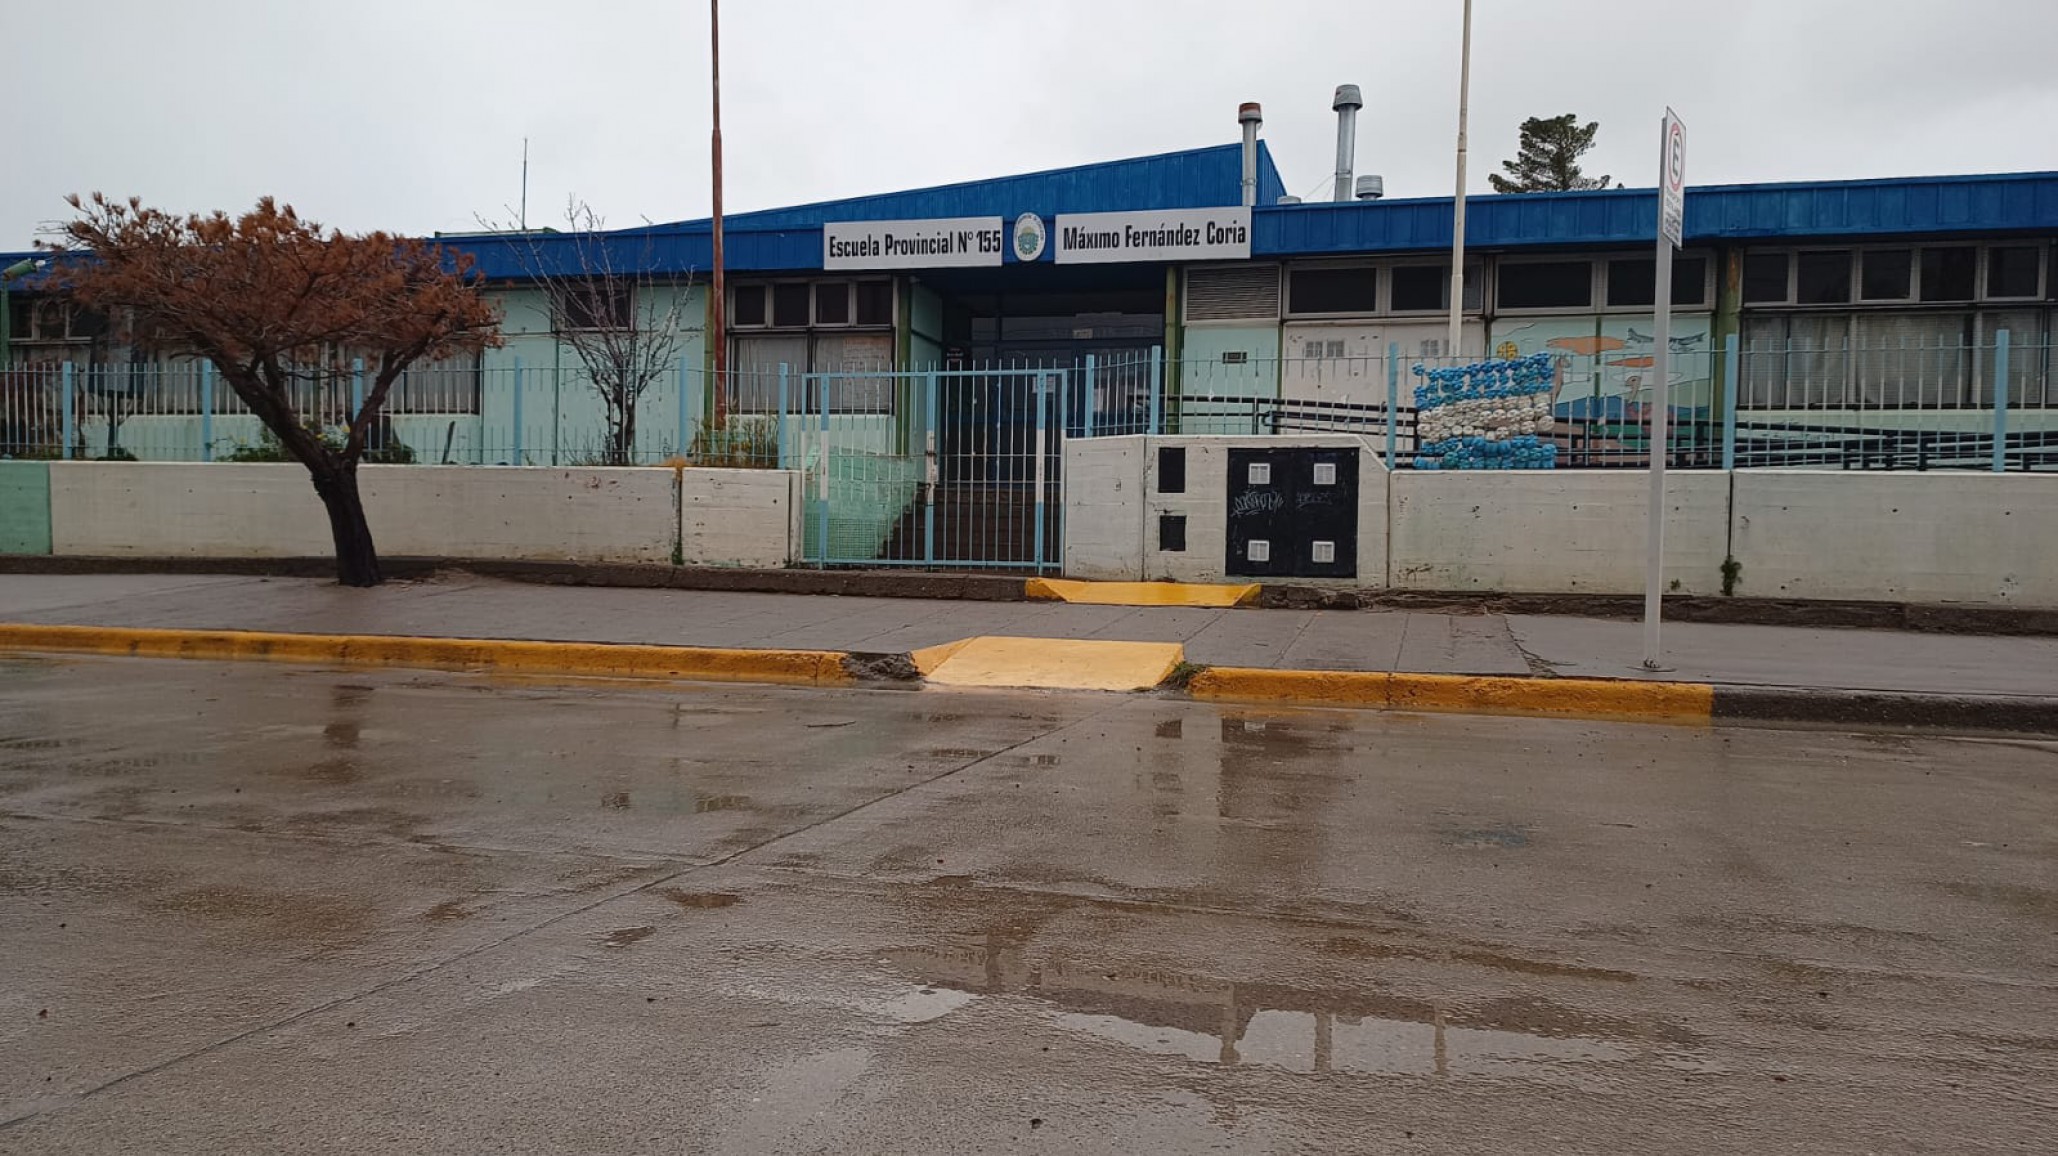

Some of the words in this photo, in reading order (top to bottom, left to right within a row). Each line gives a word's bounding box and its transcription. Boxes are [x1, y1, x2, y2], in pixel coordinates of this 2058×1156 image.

[829, 233, 880, 258] Escuela
[884, 231, 953, 256] Provincial
[976, 229, 1001, 254] 155
[1125, 222, 1201, 248] Fernández
[1206, 219, 1247, 246] Coria
